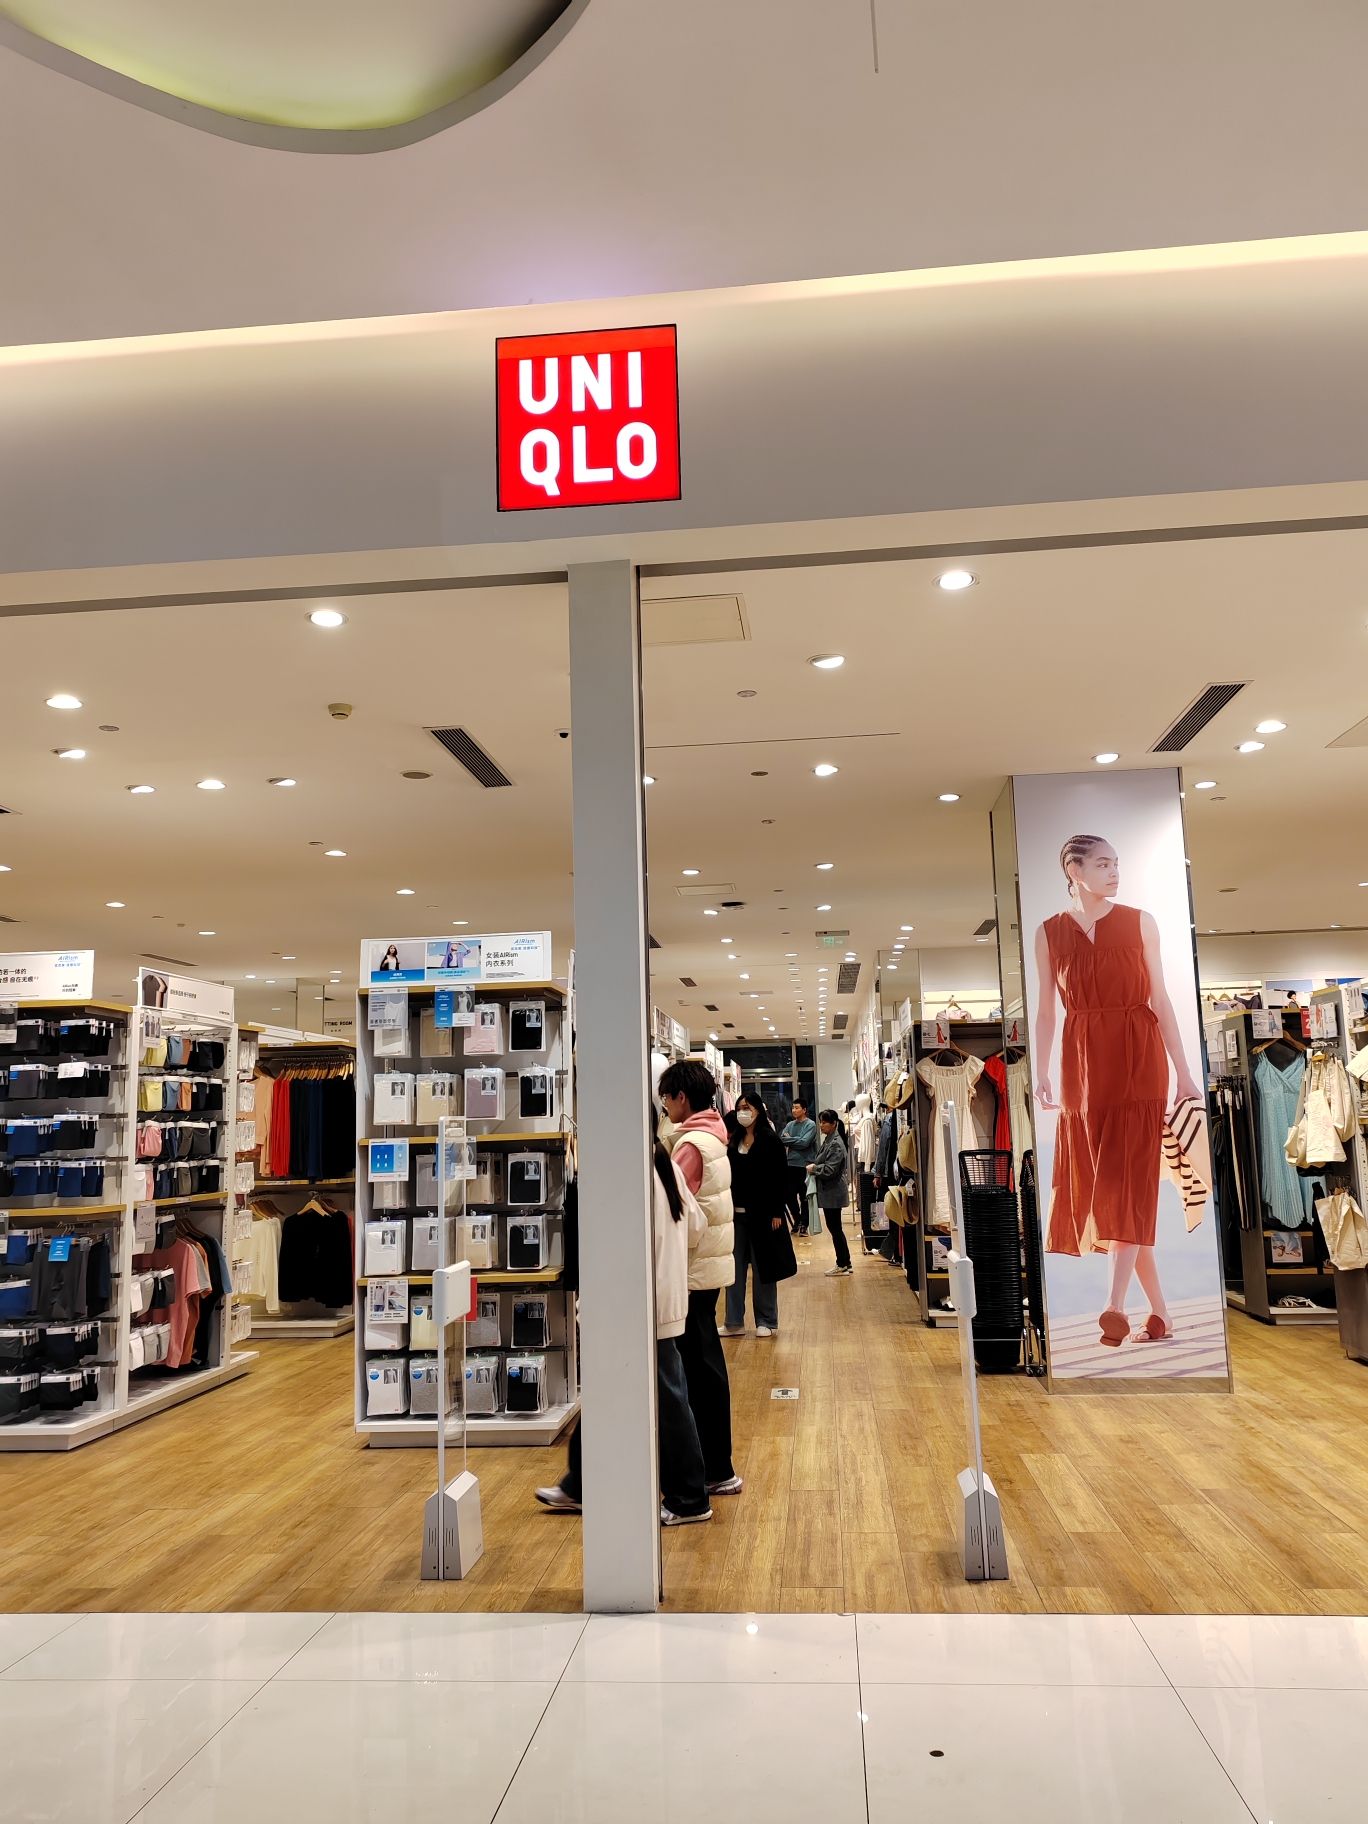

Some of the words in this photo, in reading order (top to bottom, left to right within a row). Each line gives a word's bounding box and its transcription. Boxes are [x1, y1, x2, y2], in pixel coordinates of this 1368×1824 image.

[519, 351, 643, 415] UNI
[519, 422, 658, 496] QLO
[486, 951, 518, 959] 女装AIRism
[486, 959, 514, 967] 内衣系列
